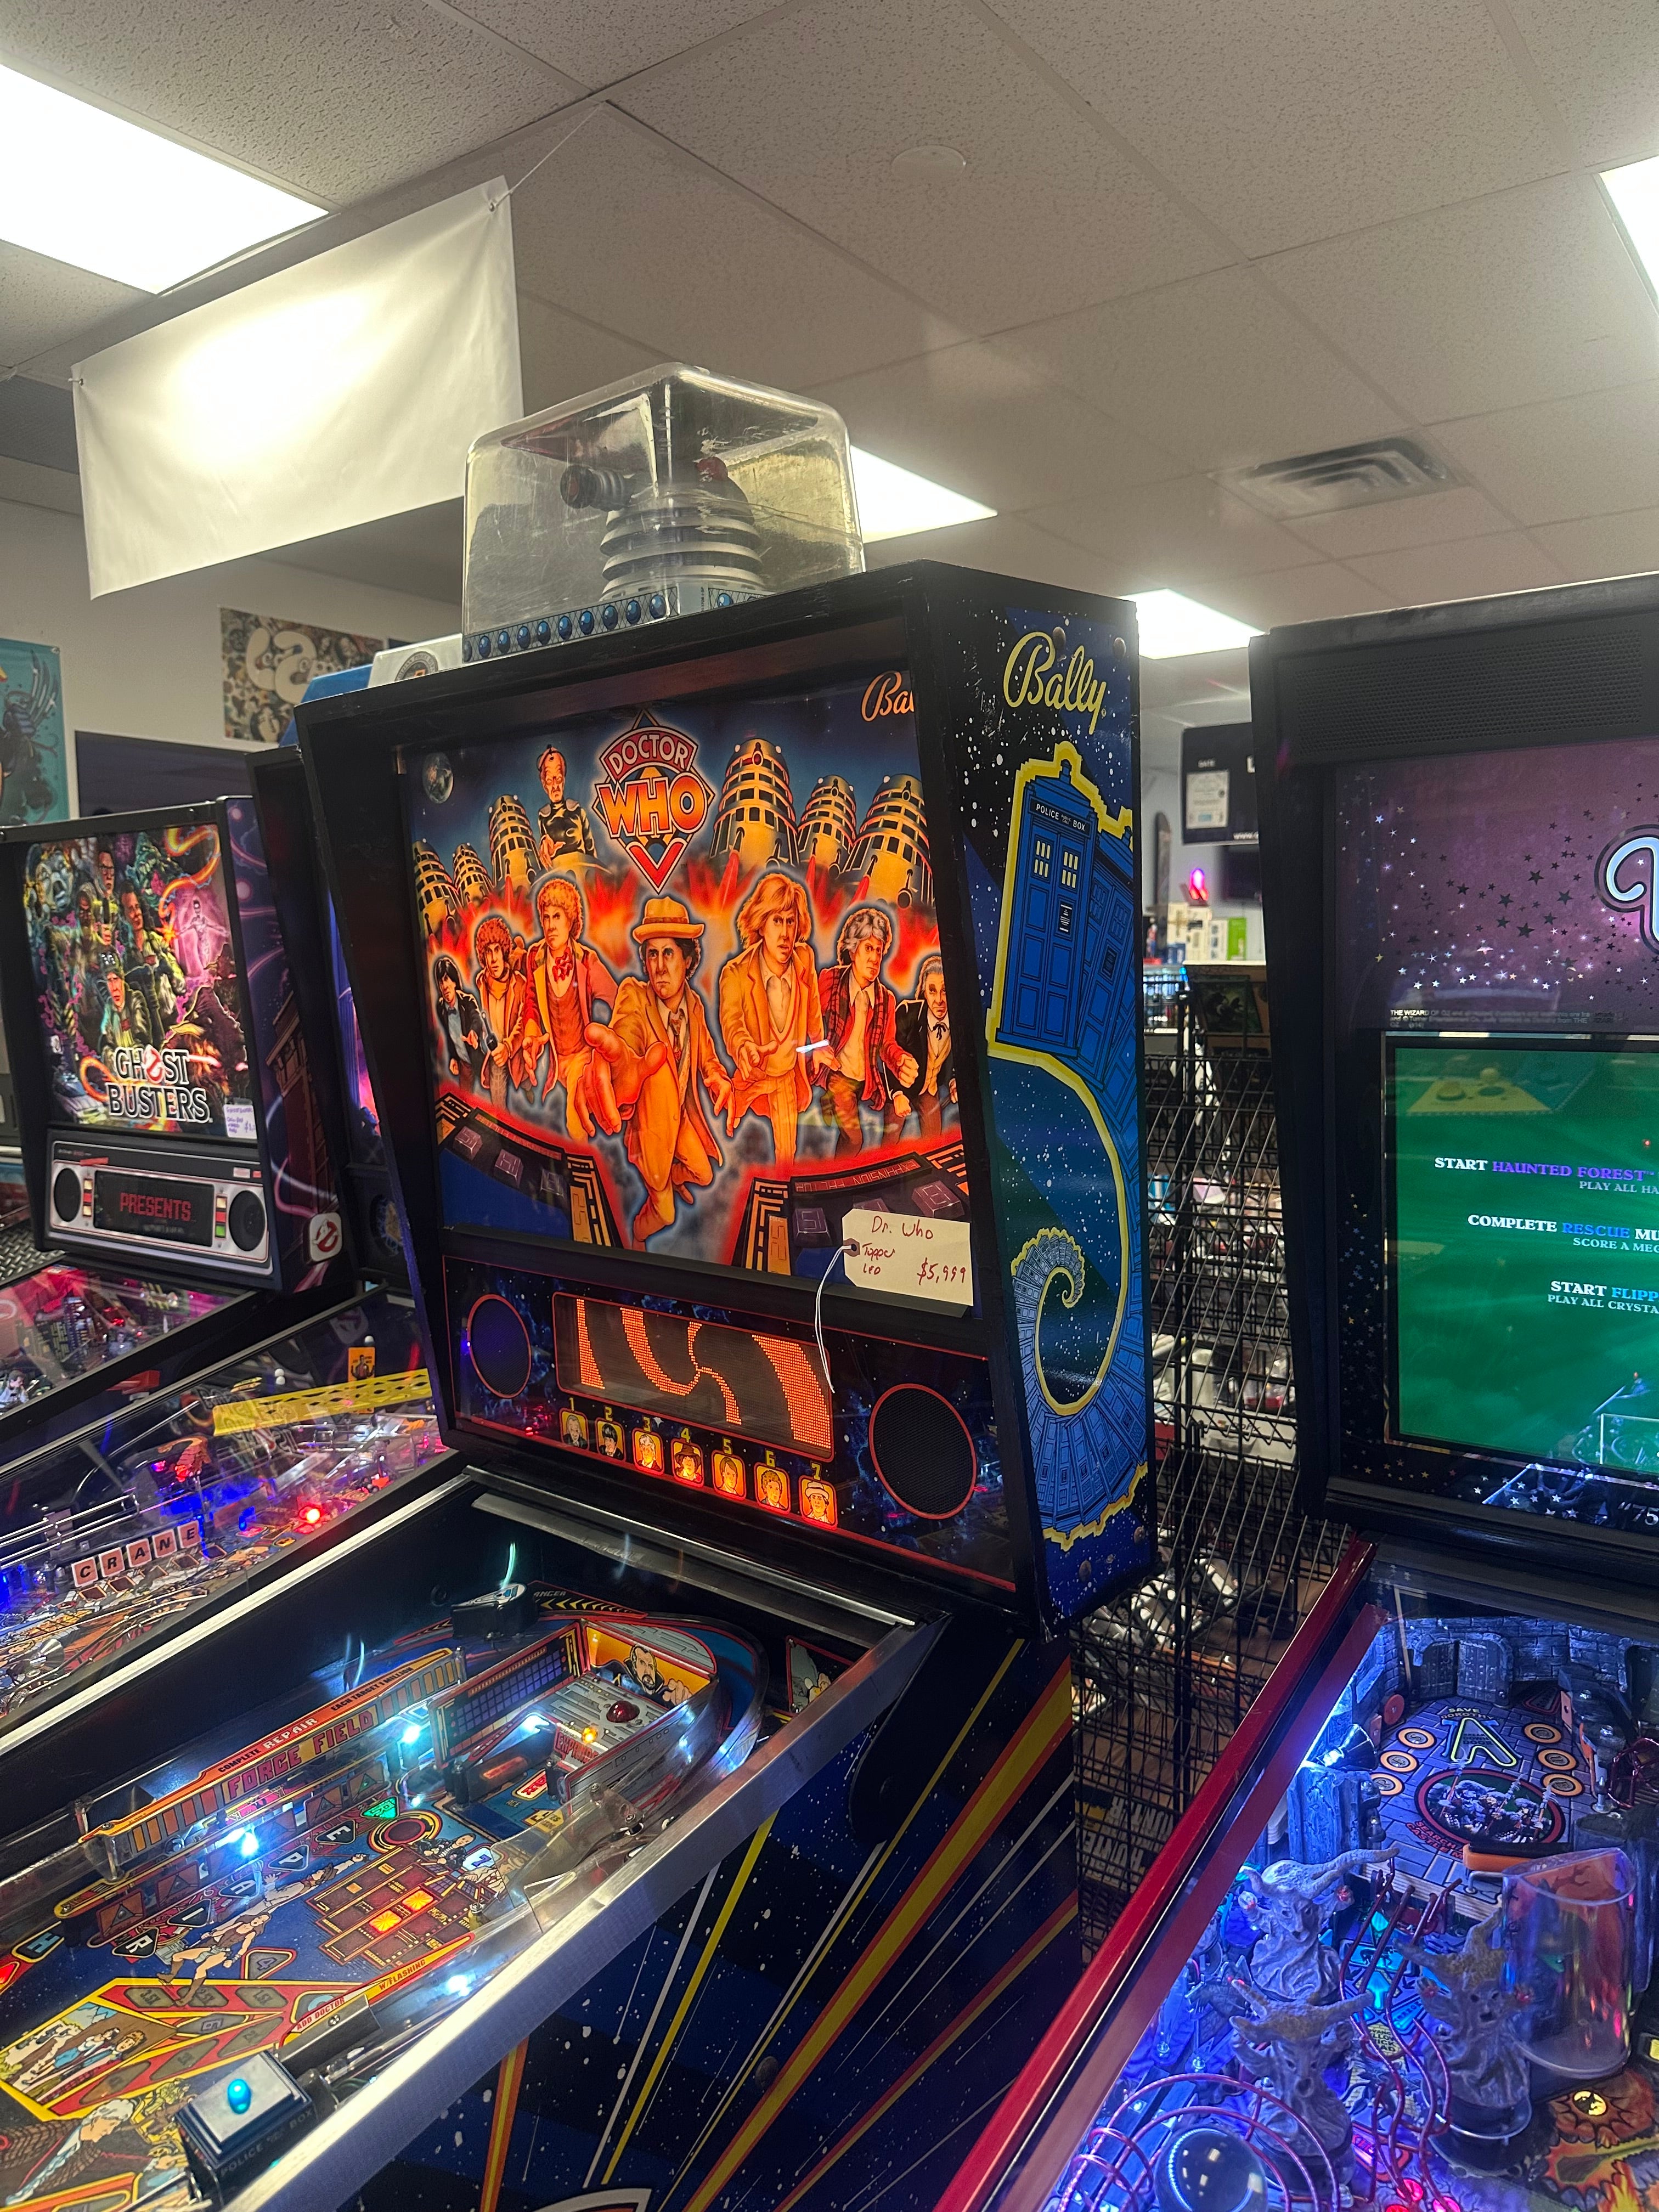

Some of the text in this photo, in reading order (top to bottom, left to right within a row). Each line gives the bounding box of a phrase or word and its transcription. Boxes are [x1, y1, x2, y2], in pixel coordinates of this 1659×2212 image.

[1003, 631, 1107, 735] Bally
[609, 735, 689, 774] DOCTOR
[595, 771, 708, 839] WHO
[1036, 803, 1086, 832] POLICE BOX
[105, 1082, 210, 1123] BUSTERS
[1435, 1157, 1488, 1171] START
[1492, 1161, 1572, 1176] HAUNTED
[1579, 1181, 1610, 1191] PLAY
[1613, 1183, 1637, 1193] ALL
[120, 1192, 191, 1221] PRESENTS
[871, 1216, 934, 1239] Dr. Who
[1468, 1214, 1558, 1232] COMPLETE
[1562, 1223, 1630, 1238] RESCUE
[1573, 1238, 1617, 1249] SCORE
[1620, 1242, 1630, 1250] A
[917, 1257, 966, 1285] $5,999
[1551, 1280, 1607, 1296] START
[1548, 1294, 1659, 1314] PLAY ALL CRYSTA
[569, 1397, 574, 1411] 1
[605, 1406, 613, 1421] 2
[644, 1417, 652, 1432] 3
[681, 1427, 691, 1443] 4
[723, 1438, 732, 1454] 5
[766, 1450, 775, 1468] 6
[811, 1463, 821, 1481] 7
[218, 1748, 262, 1773] COMPLETE
[263, 1718, 318, 1749] REPAIR
[331, 1697, 353, 1711] EACH
[351, 1684, 380, 1700] TARGET
[383, 1667, 414, 1685] MILLION
[228, 1711, 374, 1800] FORCE FIELD
[326, 1825, 351, 1841] E
[1406, 1822, 1450, 1853] CASTLE
[1415, 1820, 1457, 1849] SEARCH
[279, 1852, 304, 1865] P
[297, 1997, 345, 2030] ADD DOCTOR
[289, 2109, 313, 2129] BOX
